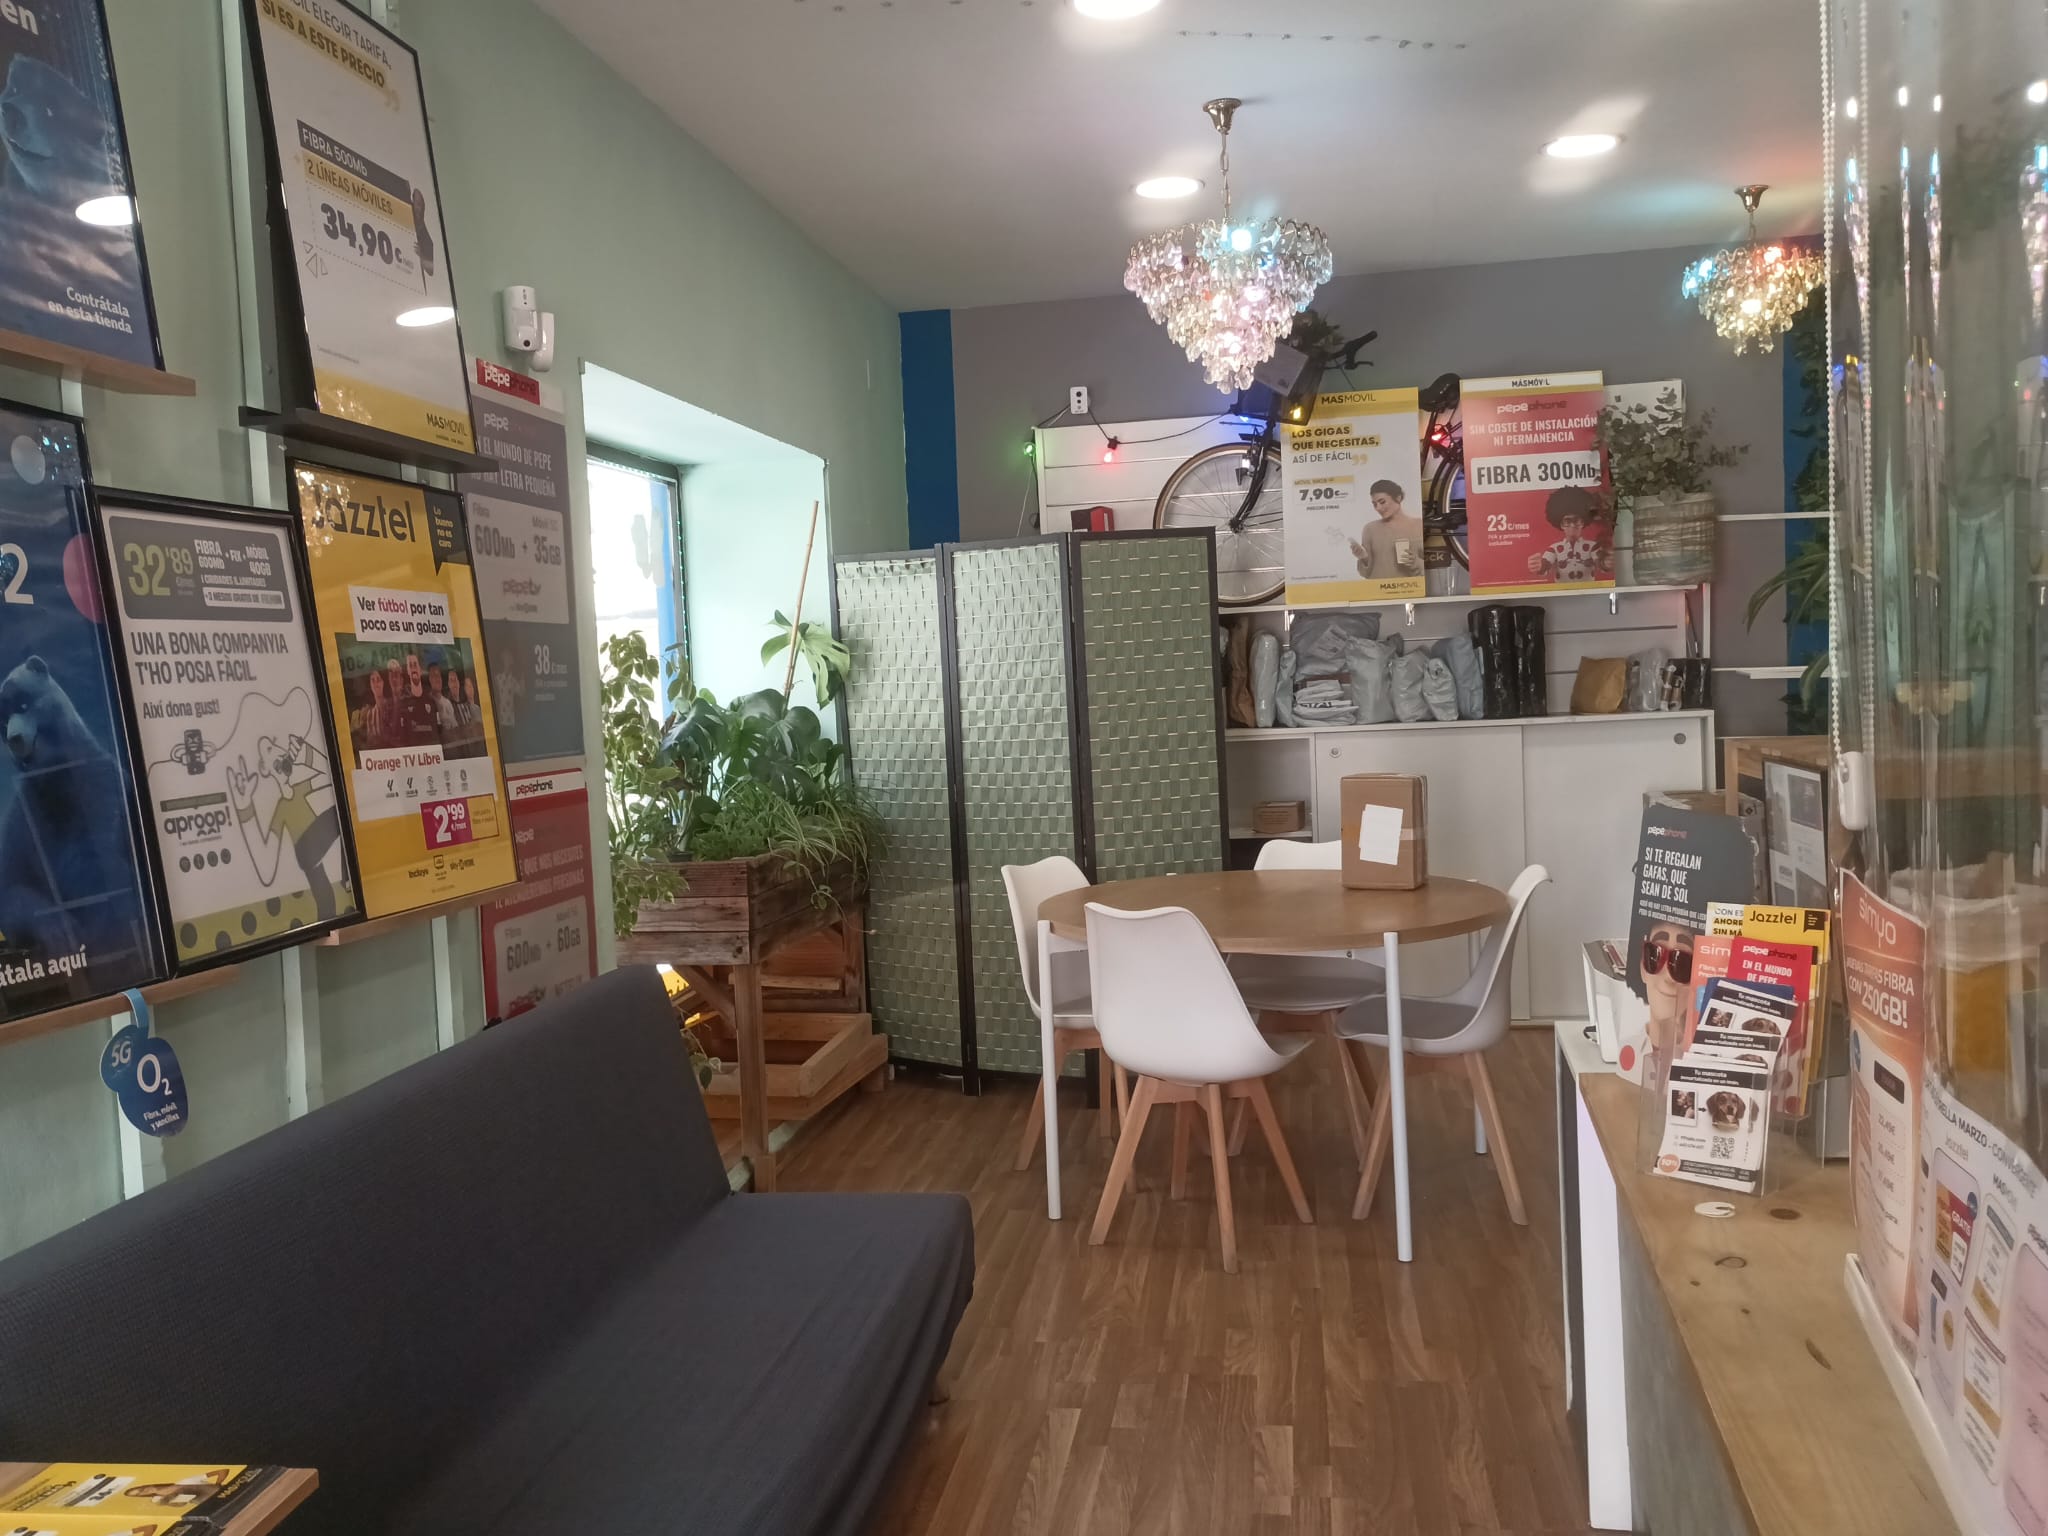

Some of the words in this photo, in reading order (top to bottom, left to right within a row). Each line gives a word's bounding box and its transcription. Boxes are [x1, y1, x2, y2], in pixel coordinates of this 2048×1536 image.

[313, 1, 351, 40] ELEGIR
[277, 6, 294, 30] ES
[297, 20, 307, 39] A
[310, 27, 338, 59] ESTE
[341, 48, 385, 88] PRECIO
[302, 128, 333, 156] FIBRA
[307, 159, 314, 176] 2
[316, 161, 349, 193] LÍNEAS
[352, 184, 393, 215] MÓVILES
[66, 287, 130, 318] Contrátala
[48, 300, 64, 314] en
[65, 307, 93, 322] esta
[94, 312, 133, 334] tienda
[1321, 393, 1376, 405] MASMOVIL
[1496, 399, 1568, 415] pepephone
[1292, 428, 1312, 439] LOS
[1314, 426, 1350, 437] GIGAS
[1470, 424, 1485, 435] SIN
[1488, 421, 1517, 434] COSTE
[1521, 421, 1533, 432] DE
[1535, 414, 1598, 431] INSTALACIÓN
[1292, 440, 1313, 451] QUE
[1316, 437, 1379, 450] NECESITAS,
[1494, 437, 1504, 447] NI
[1507, 431, 1574, 445] PERMANENCIA
[494, 439, 522, 463] MUNDO
[524, 447, 532, 466] DE
[534, 450, 552, 471] PEPE
[1292, 453, 1308, 464] ASÍ
[1310, 453, 1323, 463] DE
[1326, 450, 1352, 462] FÁCIL
[501, 468, 524, 490] LETRA
[1477, 463, 1531, 485] FIBRA
[1538, 461, 1596, 482] 300Mb
[1487, 514, 1506, 531] 23
[194, 539, 222, 556] FIBRA
[357, 596, 376, 612] Ver
[377, 597, 408, 614] fútbol
[410, 602, 426, 617] por
[428, 603, 444, 616] tan
[360, 618, 387, 633] poco
[389, 619, 400, 632] es
[402, 620, 415, 633] un
[417, 619, 448, 635] golazo
[131, 631, 167, 655] UNA
[168, 632, 209, 655] BONA
[212, 632, 288, 654] COMPANYIA
[135, 661, 171, 686] T'HO
[175, 660, 215, 684] POSA
[143, 702, 164, 719] Així
[166, 702, 194, 718] dona
[365, 756, 400, 772] Orange
[402, 755, 416, 768] TV
[419, 752, 441, 766] Libre
[516, 780, 553, 797] pepephone
[1645, 847, 1653, 861] SI
[1655, 848, 1663, 863] TE
[1665, 850, 1702, 870] REGALAN
[1643, 863, 1668, 883] GAFAS,
[1671, 869, 1687, 886] QUE
[1641, 880, 1660, 896] SEAN
[1661, 885, 1672, 899] DE
[1674, 886, 1688, 903] SOL
[1715, 908, 1733, 916] CON
[1750, 910, 1797, 925] Jazztel
[1858, 895, 1896, 948] simyo
[1713, 928, 1728, 936] SIN
[48, 944, 87, 977] aquí
[1742, 945, 1797, 960] pepephone
[1742, 960, 1753, 969] EN
[1754, 961, 1762, 971] EL
[1764, 964, 1792, 977] MUNDO
[1746, 973, 1756, 982] DE
[1883, 970, 1915, 997] FIBRA
[1848, 976, 1862, 995] CON
[1862, 979, 1908, 1029] 250GB!
[112, 1041, 131, 1067] 5G
[1958, 1118, 1988, 1147] MARZO
